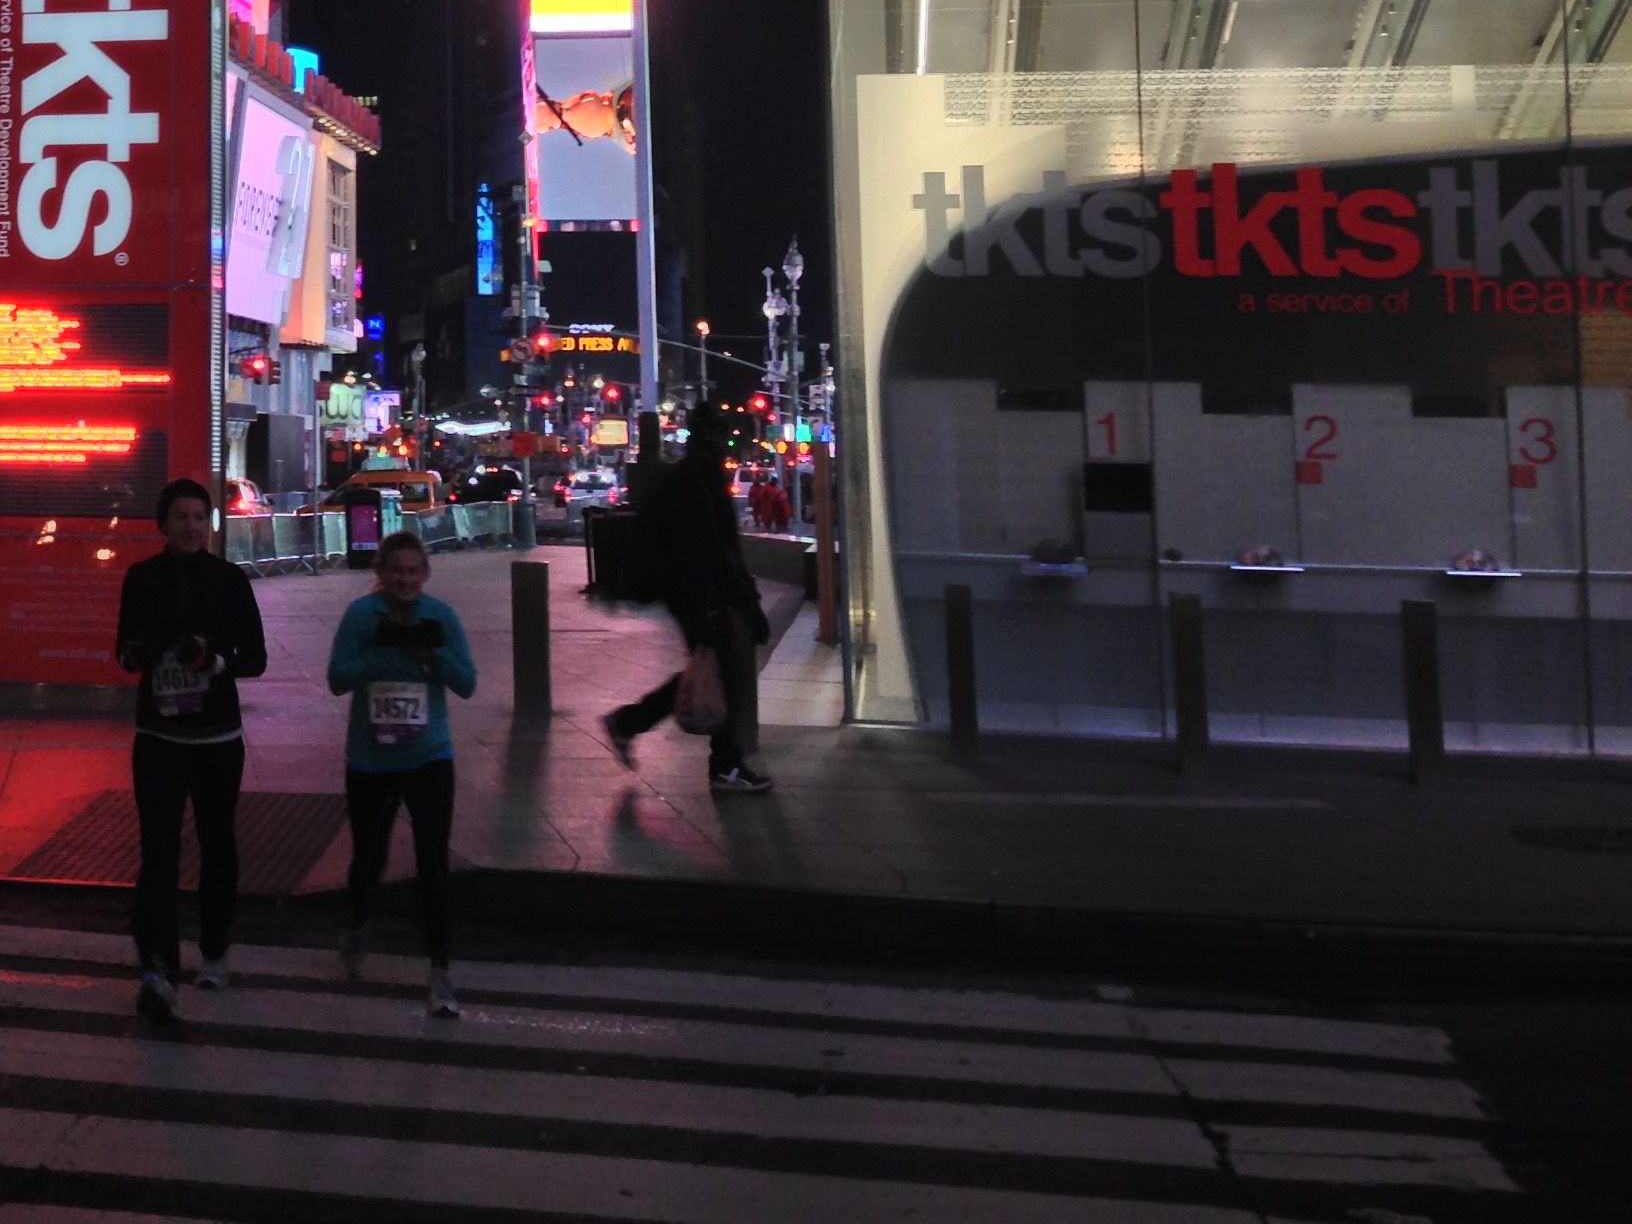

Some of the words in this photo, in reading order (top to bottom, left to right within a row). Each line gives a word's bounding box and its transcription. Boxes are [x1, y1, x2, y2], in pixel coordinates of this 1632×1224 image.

[0, 40, 12, 52] of
[912, 166, 1164, 277] tkts
[1161, 162, 1422, 278] tkts
[1238, 294, 1256, 313] a
[1267, 291, 1373, 313] service
[1383, 290, 1411, 313] of
[1096, 413, 1118, 456] 1
[1304, 415, 1340, 461] 2
[1520, 416, 1558, 464] 3
